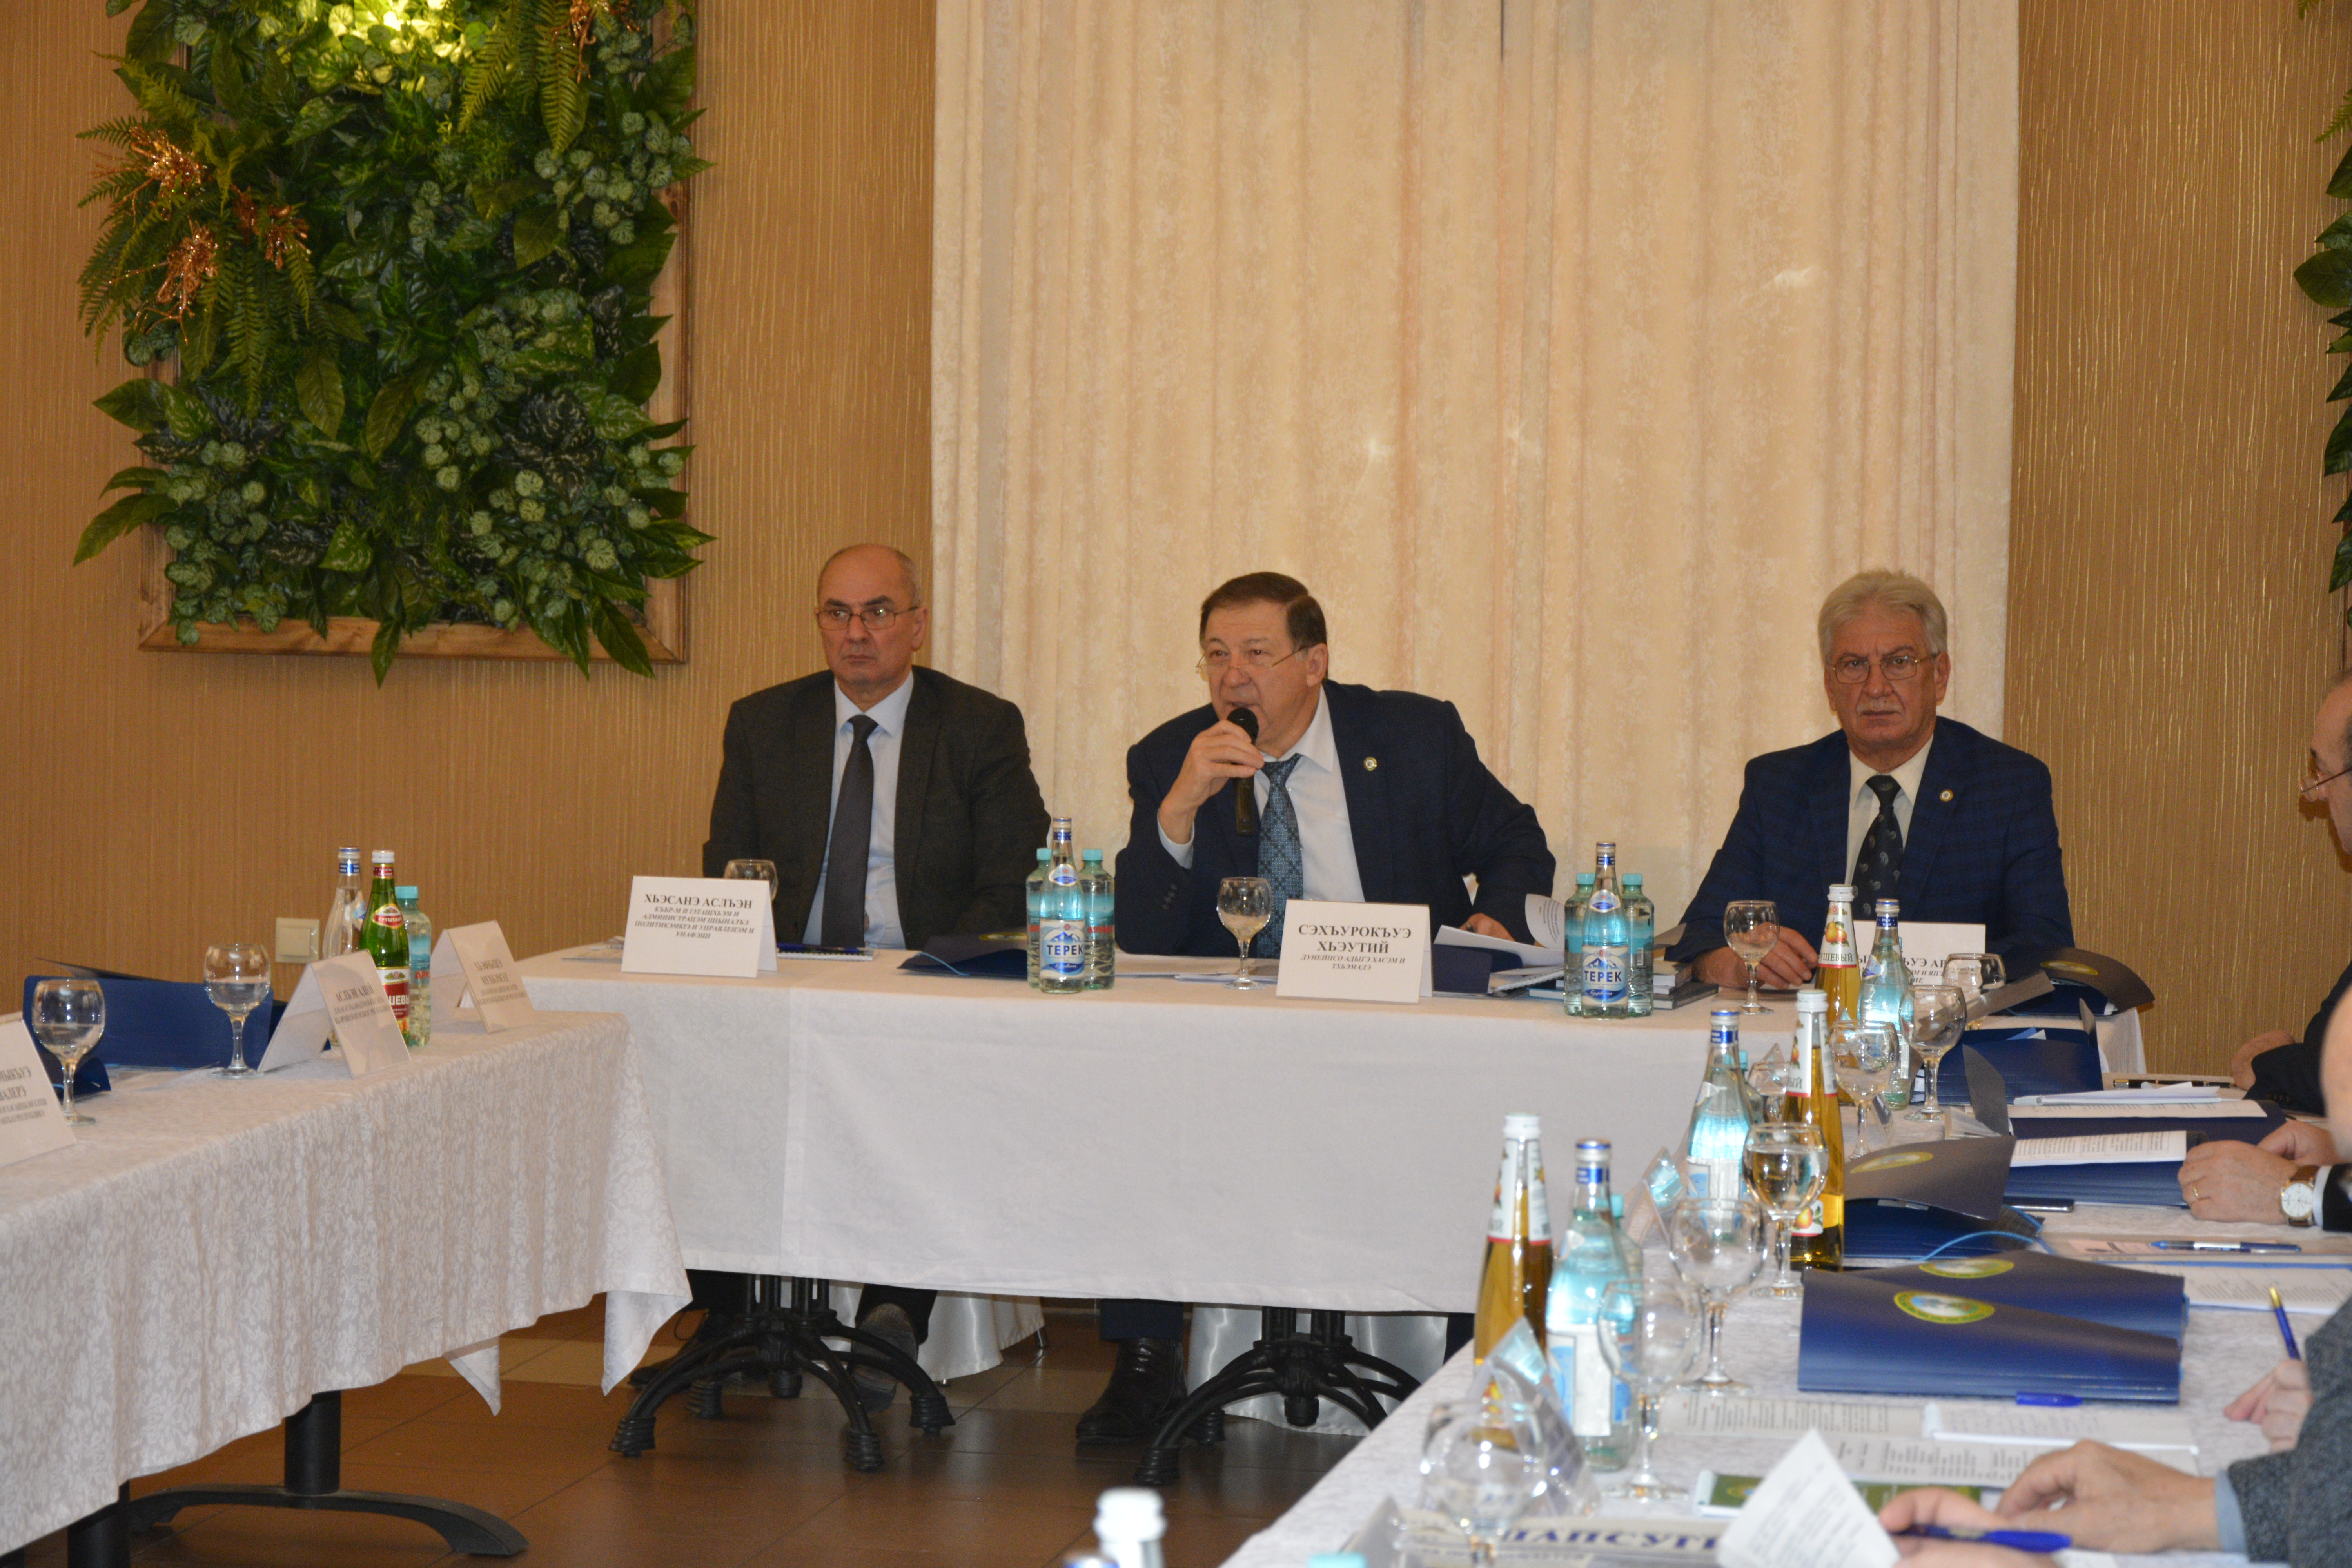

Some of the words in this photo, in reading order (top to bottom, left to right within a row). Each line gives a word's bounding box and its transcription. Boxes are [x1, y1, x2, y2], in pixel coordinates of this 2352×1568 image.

[644, 894, 699, 905] ХЬЭСАНЭ
[702, 898, 752, 909] АСЛЪЭН
[1298, 924, 1411, 938] СЭХЪУРОКЪУЭ
[1046, 944, 1083, 956] ТЕРЕК
[1318, 940, 1389, 953] ХЬЭУТИЙ
[1820, 953, 1853, 962] УШЕВЫЙ
[1584, 970, 1622, 982] ТЕРЕК
